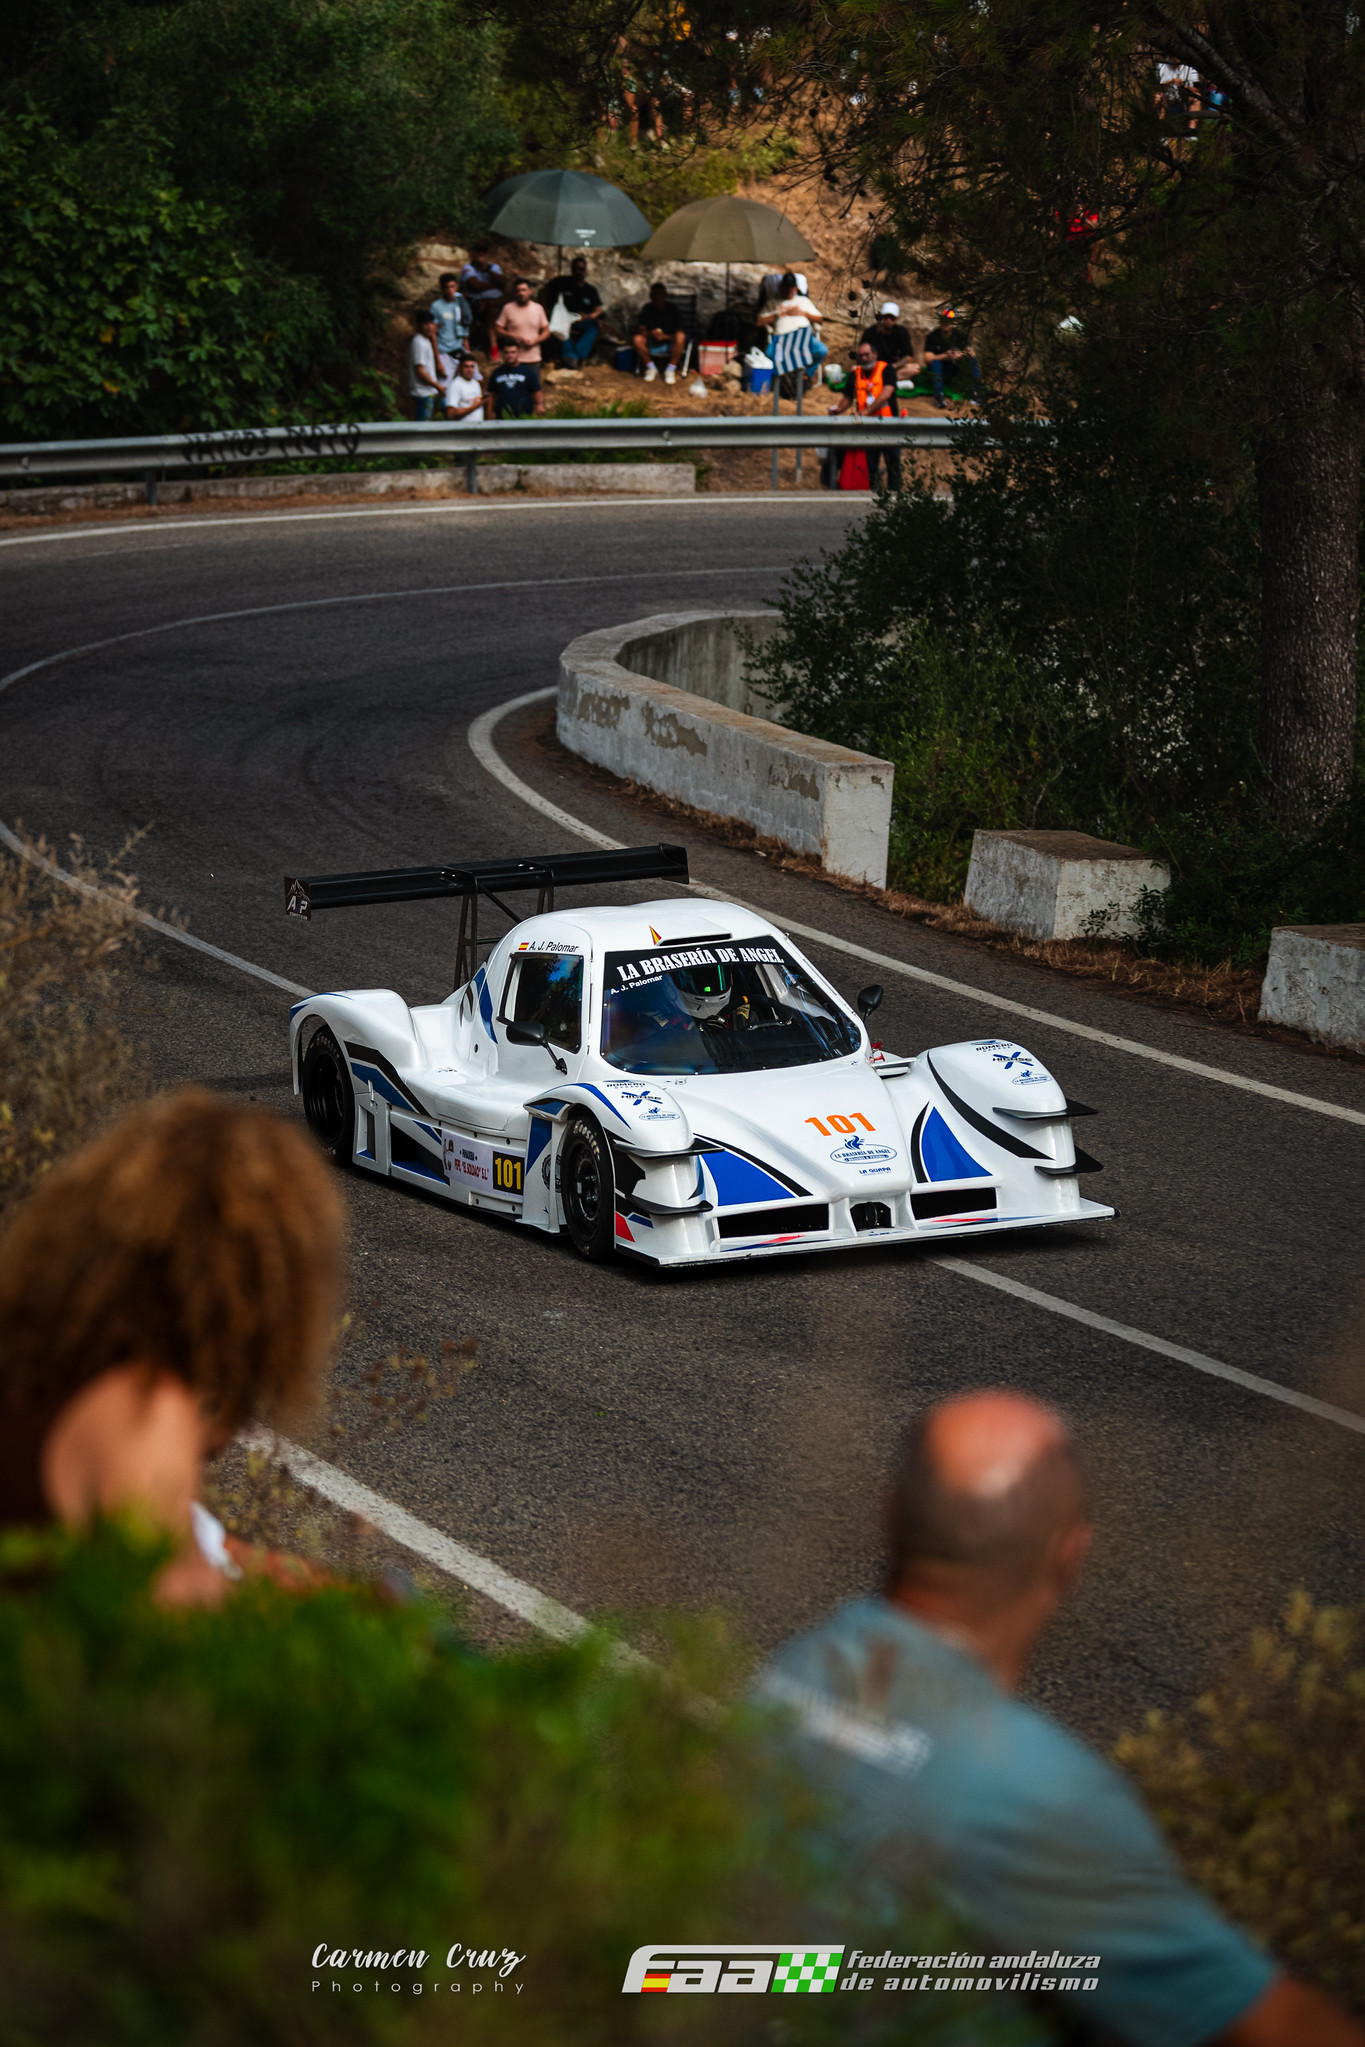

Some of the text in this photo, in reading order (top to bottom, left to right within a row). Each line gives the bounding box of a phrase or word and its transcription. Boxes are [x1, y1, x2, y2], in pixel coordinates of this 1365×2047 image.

[529, 941, 579, 952] A. J. Palomar
[617, 948, 785, 981] LA BRASERÍA DE ANGEL
[629, 975, 663, 988] Palomar
[804, 1112, 876, 1137] 101
[495, 1157, 522, 1190] 101
